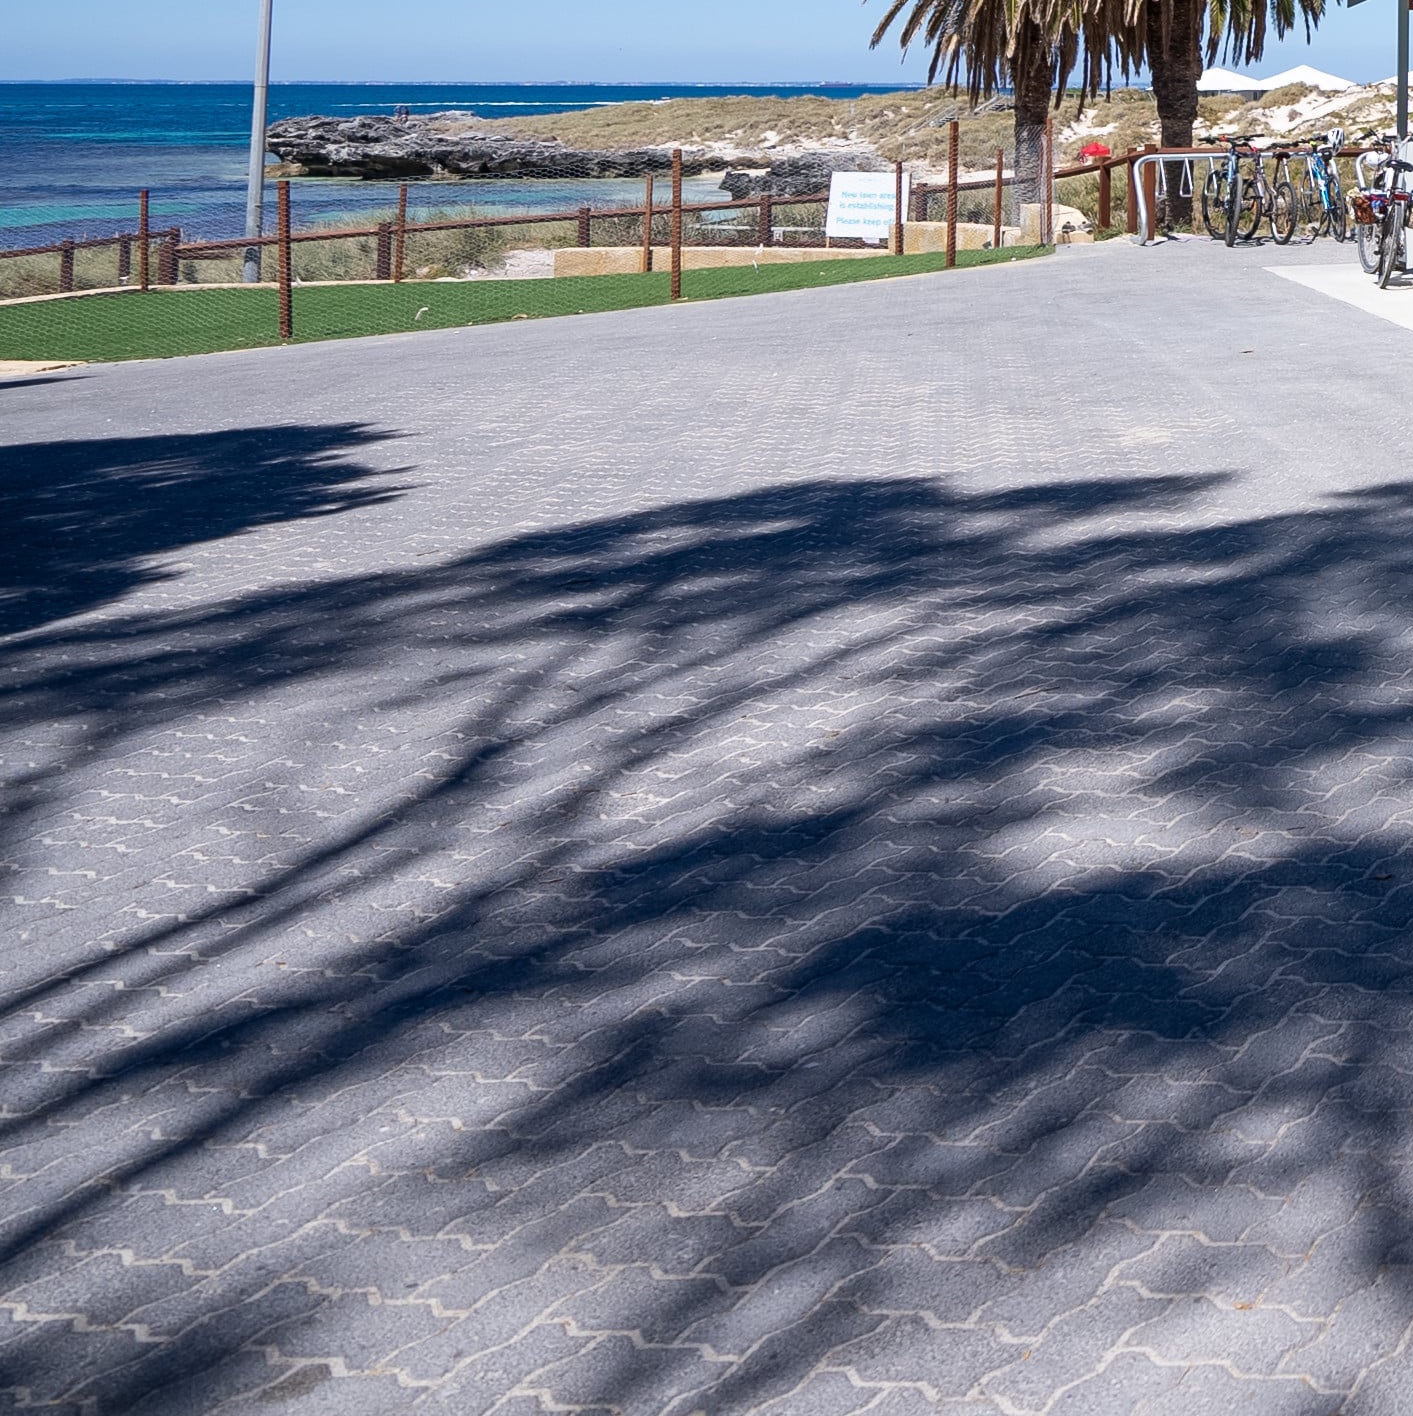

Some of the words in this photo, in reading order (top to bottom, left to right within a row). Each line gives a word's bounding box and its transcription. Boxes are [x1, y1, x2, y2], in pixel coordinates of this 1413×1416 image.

[841, 191, 857, 199] New
[836, 217, 860, 225] Please
[863, 217, 881, 226] keep
